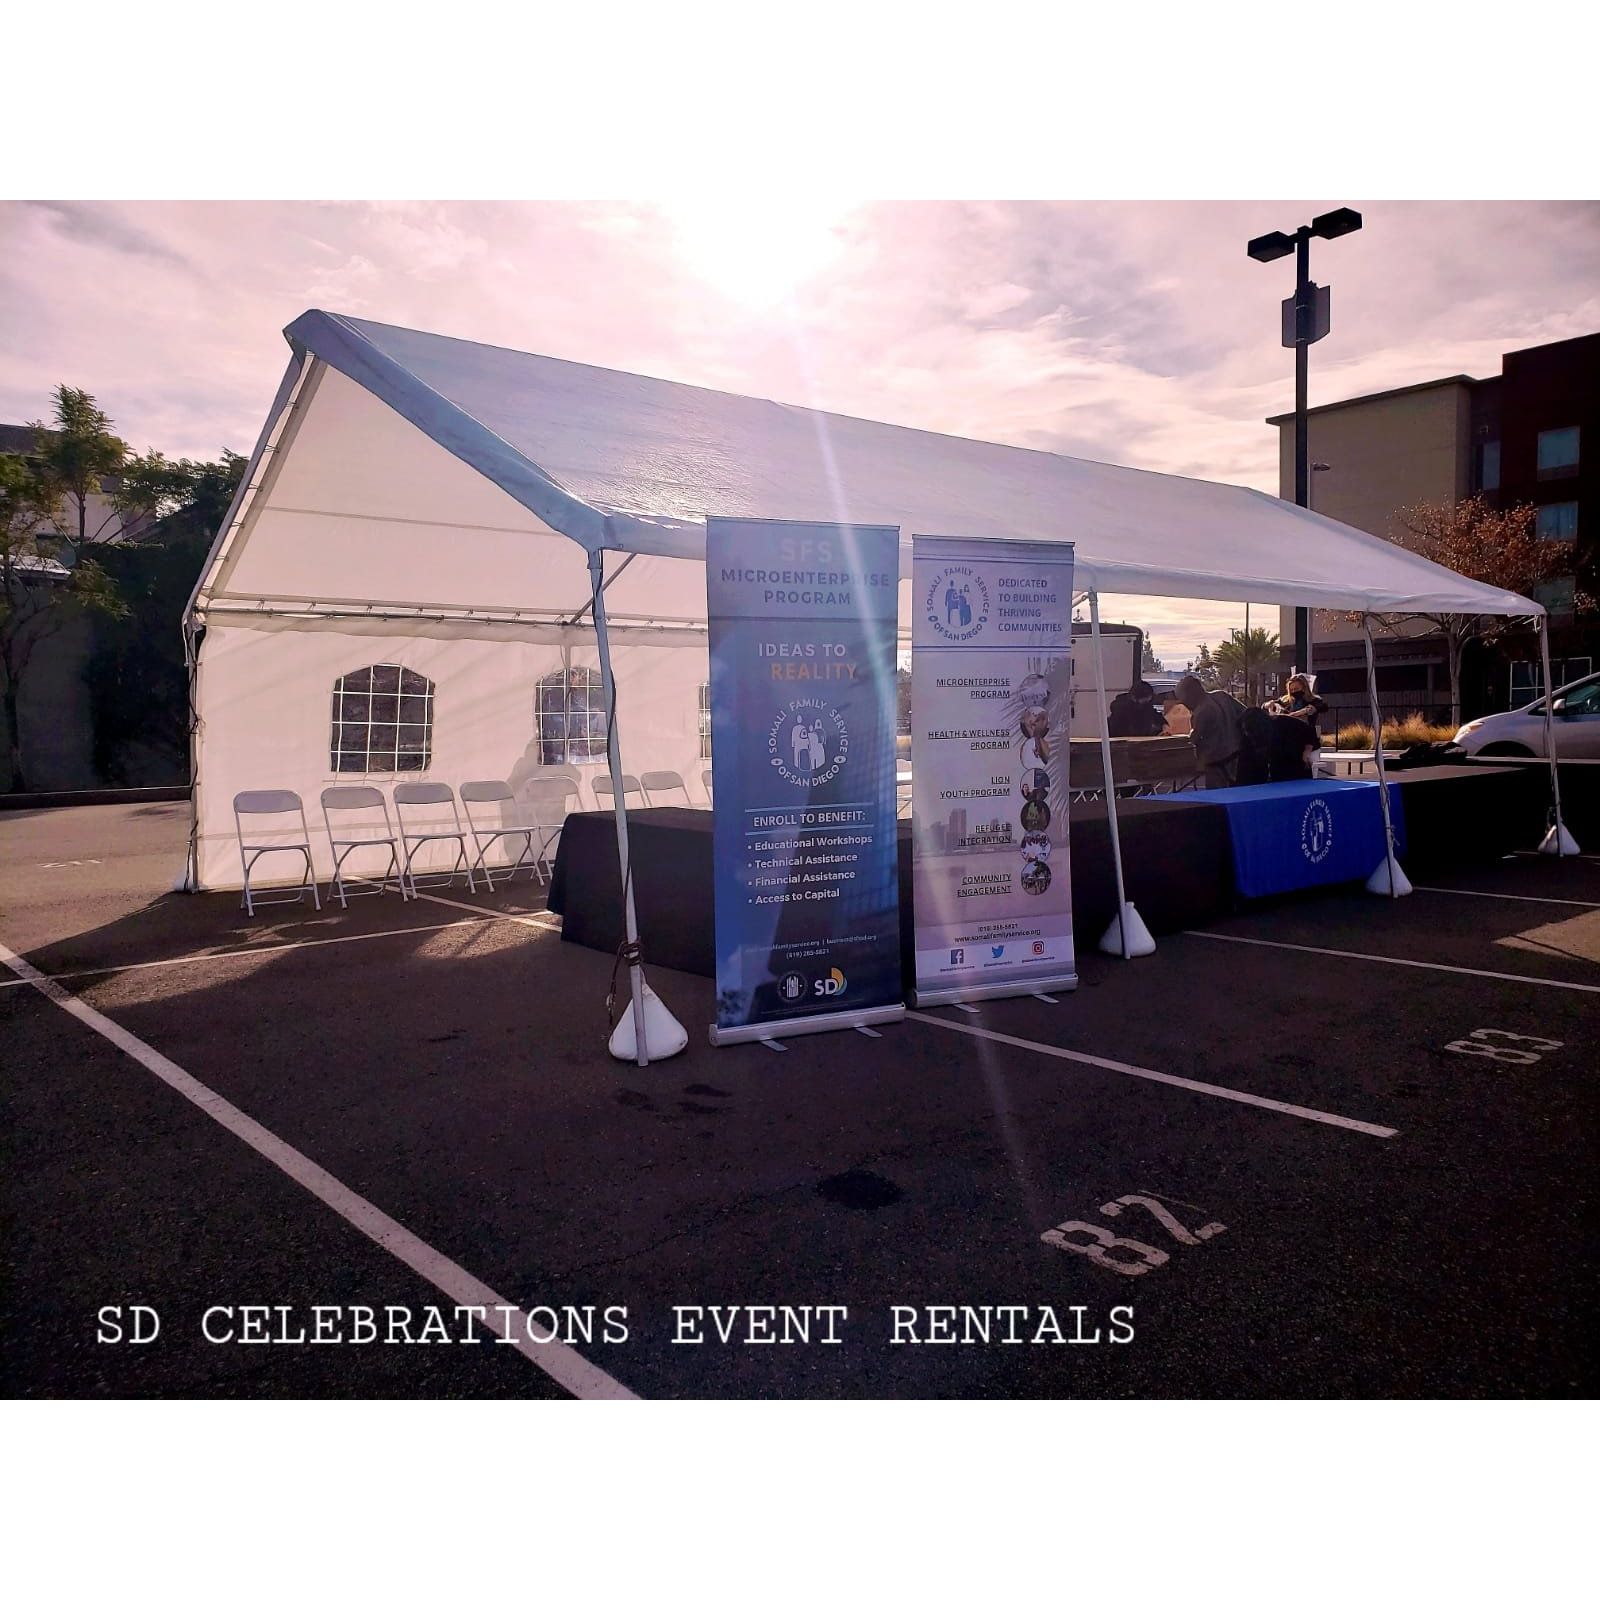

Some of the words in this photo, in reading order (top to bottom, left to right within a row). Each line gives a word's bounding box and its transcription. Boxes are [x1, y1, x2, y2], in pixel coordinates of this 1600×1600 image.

[780, 538, 833, 563] SFS
[721, 568, 890, 587] MICROENTERPRISE
[998, 578, 1048, 588] DEDICATED
[764, 590, 851, 605] PROGRAM
[927, 576, 942, 612] SOMALI
[944, 566, 973, 576] FAMILY
[975, 576, 989, 614] SERVICE
[998, 593, 1011, 603] TO
[1013, 594, 1056, 603] BUILDING
[998, 608, 1041, 617] THRIVING
[934, 622, 944, 633] OF
[943, 630, 960, 641] SAN
[961, 624, 983, 641] DIEGO
[998, 623, 1062, 632] COMMUNITIES
[758, 643, 815, 657] IDEAS
[822, 643, 846, 657] TO
[771, 662, 857, 681] REALITY
[936, 678, 1010, 687] MICROENTERPRISE
[970, 690, 1010, 699] PROGRAM
[768, 710, 787, 754] SOMALI
[789, 698, 827, 711] FAMILY
[829, 709, 849, 753] SERVICE
[928, 730, 960, 739] HEALTH
[969, 729, 1010, 737] WELLNESS
[971, 741, 1010, 750] PROGRAM
[778, 766, 791, 779] OF
[790, 774, 810, 787] SAN
[812, 764, 840, 787] DIEGO
[991, 776, 1010, 784] LION
[940, 789, 968, 799] YOUTH
[971, 788, 1010, 797] PROGRAM
[753, 815, 797, 827] ENROLL
[800, 813, 815, 824] TO
[818, 810, 866, 823] BENEFIT:
[755, 835, 814, 851] Educational
[816, 834, 873, 848] Workshops
[755, 856, 802, 869] Technical
[805, 853, 858, 866] Assistance
[755, 874, 800, 887] Financial
[802, 871, 856, 882] Assistance
[962, 873, 1011, 885] COMMUNITY
[755, 893, 790, 905] Access
[791, 892, 803, 901] to
[804, 888, 840, 900] Capital
[957, 885, 1011, 897] ENGAGEMENT
[814, 978, 839, 995] SD
[1443, 1028, 1565, 1065] 83
[1040, 1193, 1228, 1276] 82
